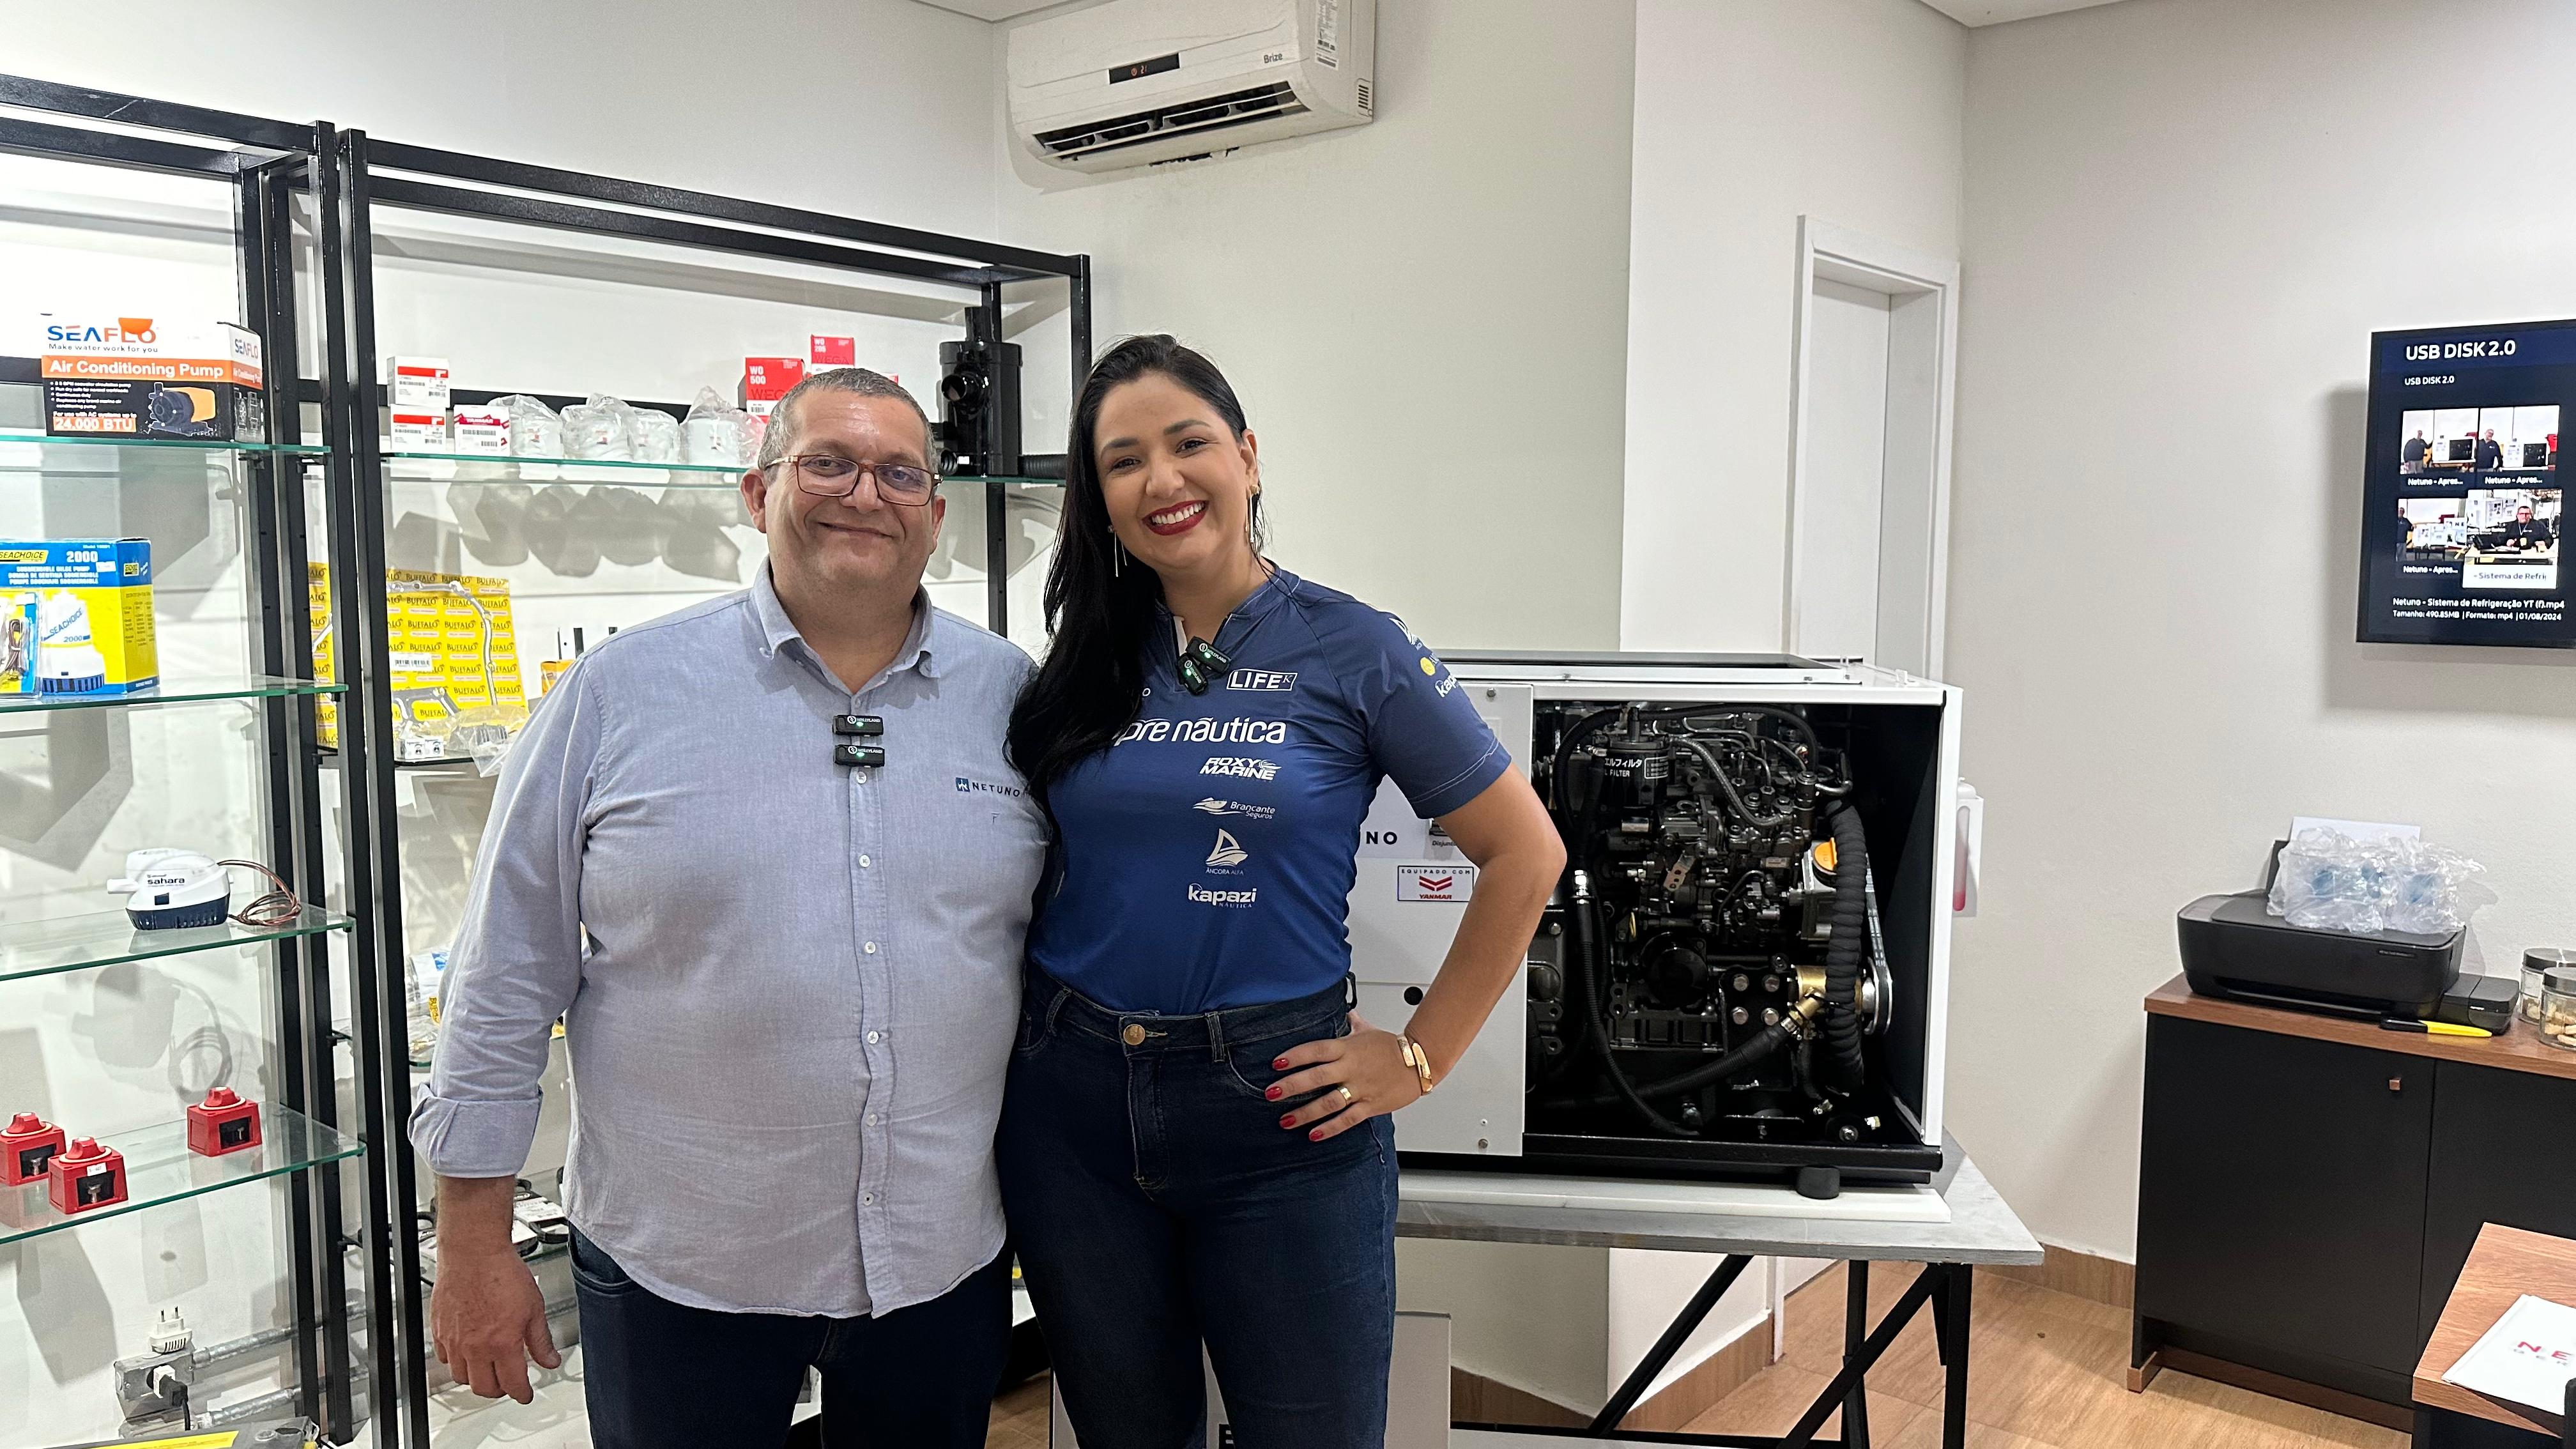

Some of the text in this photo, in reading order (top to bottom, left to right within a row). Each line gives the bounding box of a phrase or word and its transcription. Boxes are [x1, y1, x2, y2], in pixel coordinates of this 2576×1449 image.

[47, 325, 157, 344] SEAFLO
[234, 339, 259, 359] SEAFLO
[2406, 340, 2516, 360] USB DISK 2.0
[49, 360, 224, 379] Air Conditioning Pump
[749, 376, 766, 385] 500
[2404, 376, 2455, 385] USB DISK 2.0
[751, 389, 785, 399] WEG
[103, 418, 133, 431] BTU
[66, 551, 98, 563] 2000
[406, 597, 438, 606] BUFFALO
[2393, 598, 2421, 606] Netuno
[2428, 598, 2458, 606] Sistema
[2471, 599, 2522, 610] Refrigeração
[2524, 600, 2534, 608] YT
[50, 607, 82, 634] SEACHOICE
[2497, 612, 2513, 620] mp4
[408, 620, 440, 629] BUFFALO
[445, 620, 476, 630] BUFFALO
[480, 621, 511, 630] BFALO
[410, 643, 442, 652] BUFFALO
[447, 643, 479, 652] BUFFALO
[491, 643, 514, 652] FFALO
[450, 664, 481, 673] BUFFALO
[1230, 671, 1283, 689] LIFE
[454, 686, 521, 694] BUFFALO UFFALO
[1435, 675, 1457, 698] kap
[1113, 719, 1170, 747] pre
[1205, 757, 1262, 767] ROXY
[1604, 758, 1643, 768] エルフィルタ
[1199, 765, 1276, 781] MARINE
[1609, 769, 1630, 777] FILTER
[972, 781, 1021, 797] NETUNO
[1230, 801, 1276, 815] Brancante
[1245, 810, 1273, 819] Seguros
[1366, 831, 1398, 845] NO
[1188, 884, 1257, 906] kapazi
[2517, 1341, 2573, 1361] NE
